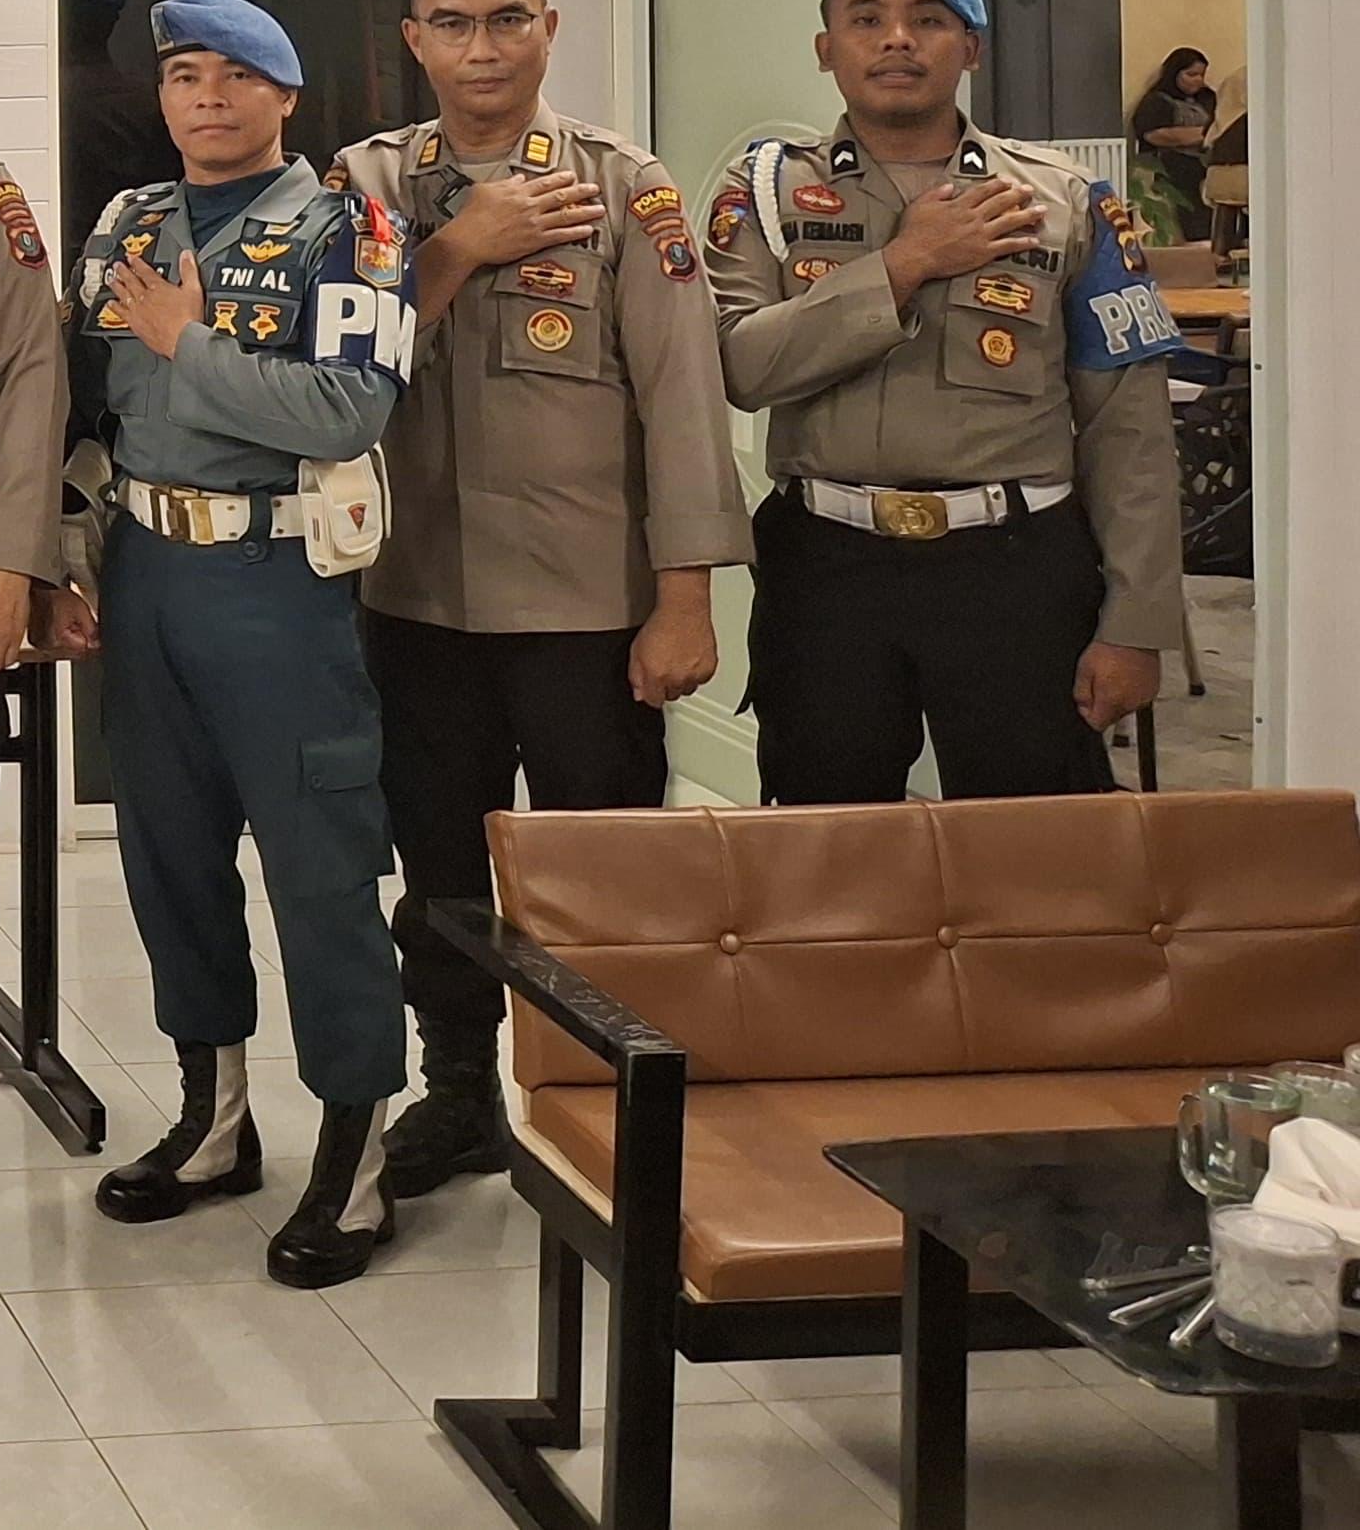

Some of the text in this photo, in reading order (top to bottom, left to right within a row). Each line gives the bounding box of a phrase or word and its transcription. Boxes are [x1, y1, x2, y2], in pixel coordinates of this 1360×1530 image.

[220, 267, 291, 293] TNI AL
[314, 282, 418, 386] PM
